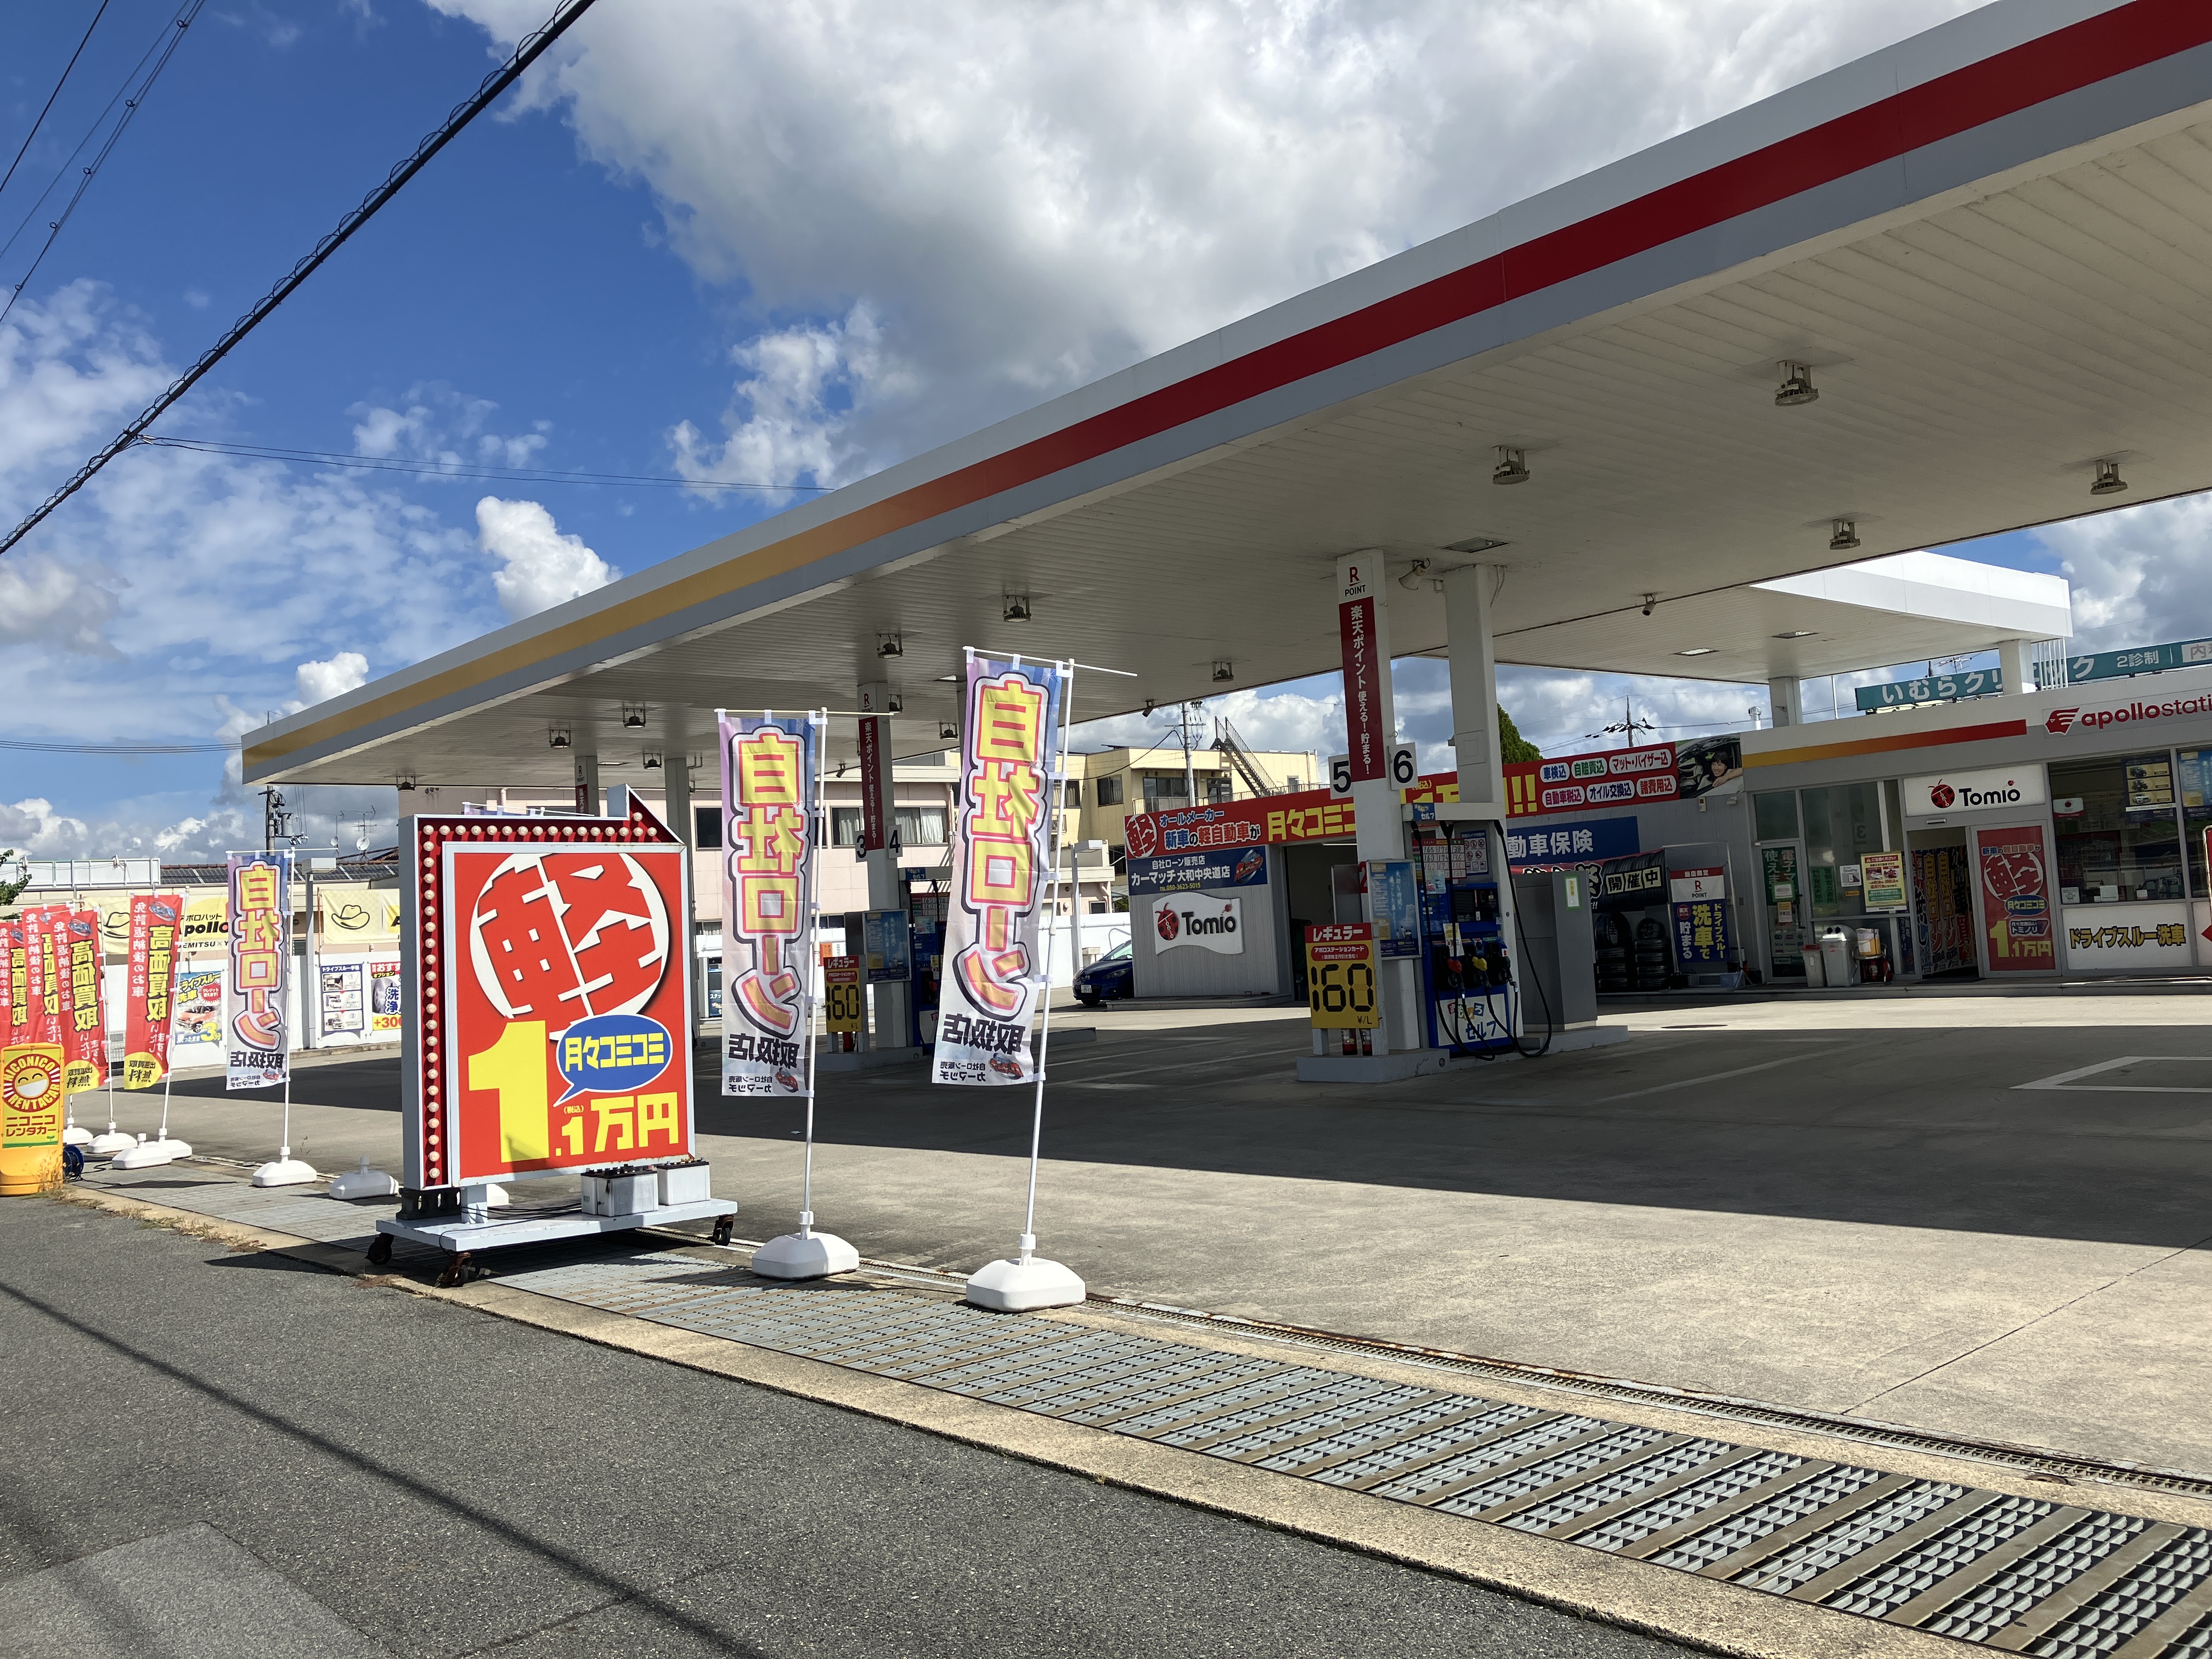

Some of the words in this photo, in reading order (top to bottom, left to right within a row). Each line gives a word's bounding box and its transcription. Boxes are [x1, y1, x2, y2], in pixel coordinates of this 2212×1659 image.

[1349, 566, 1360, 583] R
[1345, 585, 1366, 597] POINT
[2117, 650, 2159, 668] 2診制
[2190, 644, 2212, 659] 内
[864, 693, 870, 704] R
[1333, 760, 1352, 793] 5
[1393, 750, 1414, 783] 6
[1543, 765, 1566, 780] 車検込
[1574, 760, 1605, 776] 自賠責込
[1612, 752, 1668, 770] マット・バイザー込
[1545, 789, 1582, 805] 自動車税込
[1590, 783, 1632, 800] オイル交換込
[1640, 777, 1672, 795] 諸費用込
[1959, 787, 2021, 806] Tomio
[1159, 808, 1224, 827] オールメーカー
[857, 834, 866, 859] 3
[889, 830, 900, 854] 4
[1165, 822, 1261, 850] 新車の軽自動車が
[1152, 855, 1205, 870] 自社ローン販売店
[1608, 870, 1658, 892] 開催中
[1695, 880, 1702, 890] R
[2007, 900, 2045, 910] 月々コミコミ
[1182, 912, 1236, 935] Tomio
[1313, 926, 1363, 941] レギュラー
[1692, 904, 1714, 960] 洗車で
[1714, 903, 1726, 959] ドライブスルー
[1679, 922, 1692, 959] 貯まる
[2069, 923, 2186, 949] ドライブスルー洗車
[827, 957, 855, 968] レギュラー
[1311, 963, 1374, 1012] 160
[387, 989, 399, 1013] 洗浄
[826, 985, 860, 1021] 160
[1357, 1015, 1372, 1024] ¥/L
[565, 1032, 664, 1072] 月々コミコミ
[4, 1056, 55, 1081] NICONICO
[8, 1084, 60, 1110] RENTACAR
[563, 1104, 584, 1114] (税込)
[6, 1126, 57, 1137] レンタカー
[7, 1114, 56, 1127] ニコニコ
